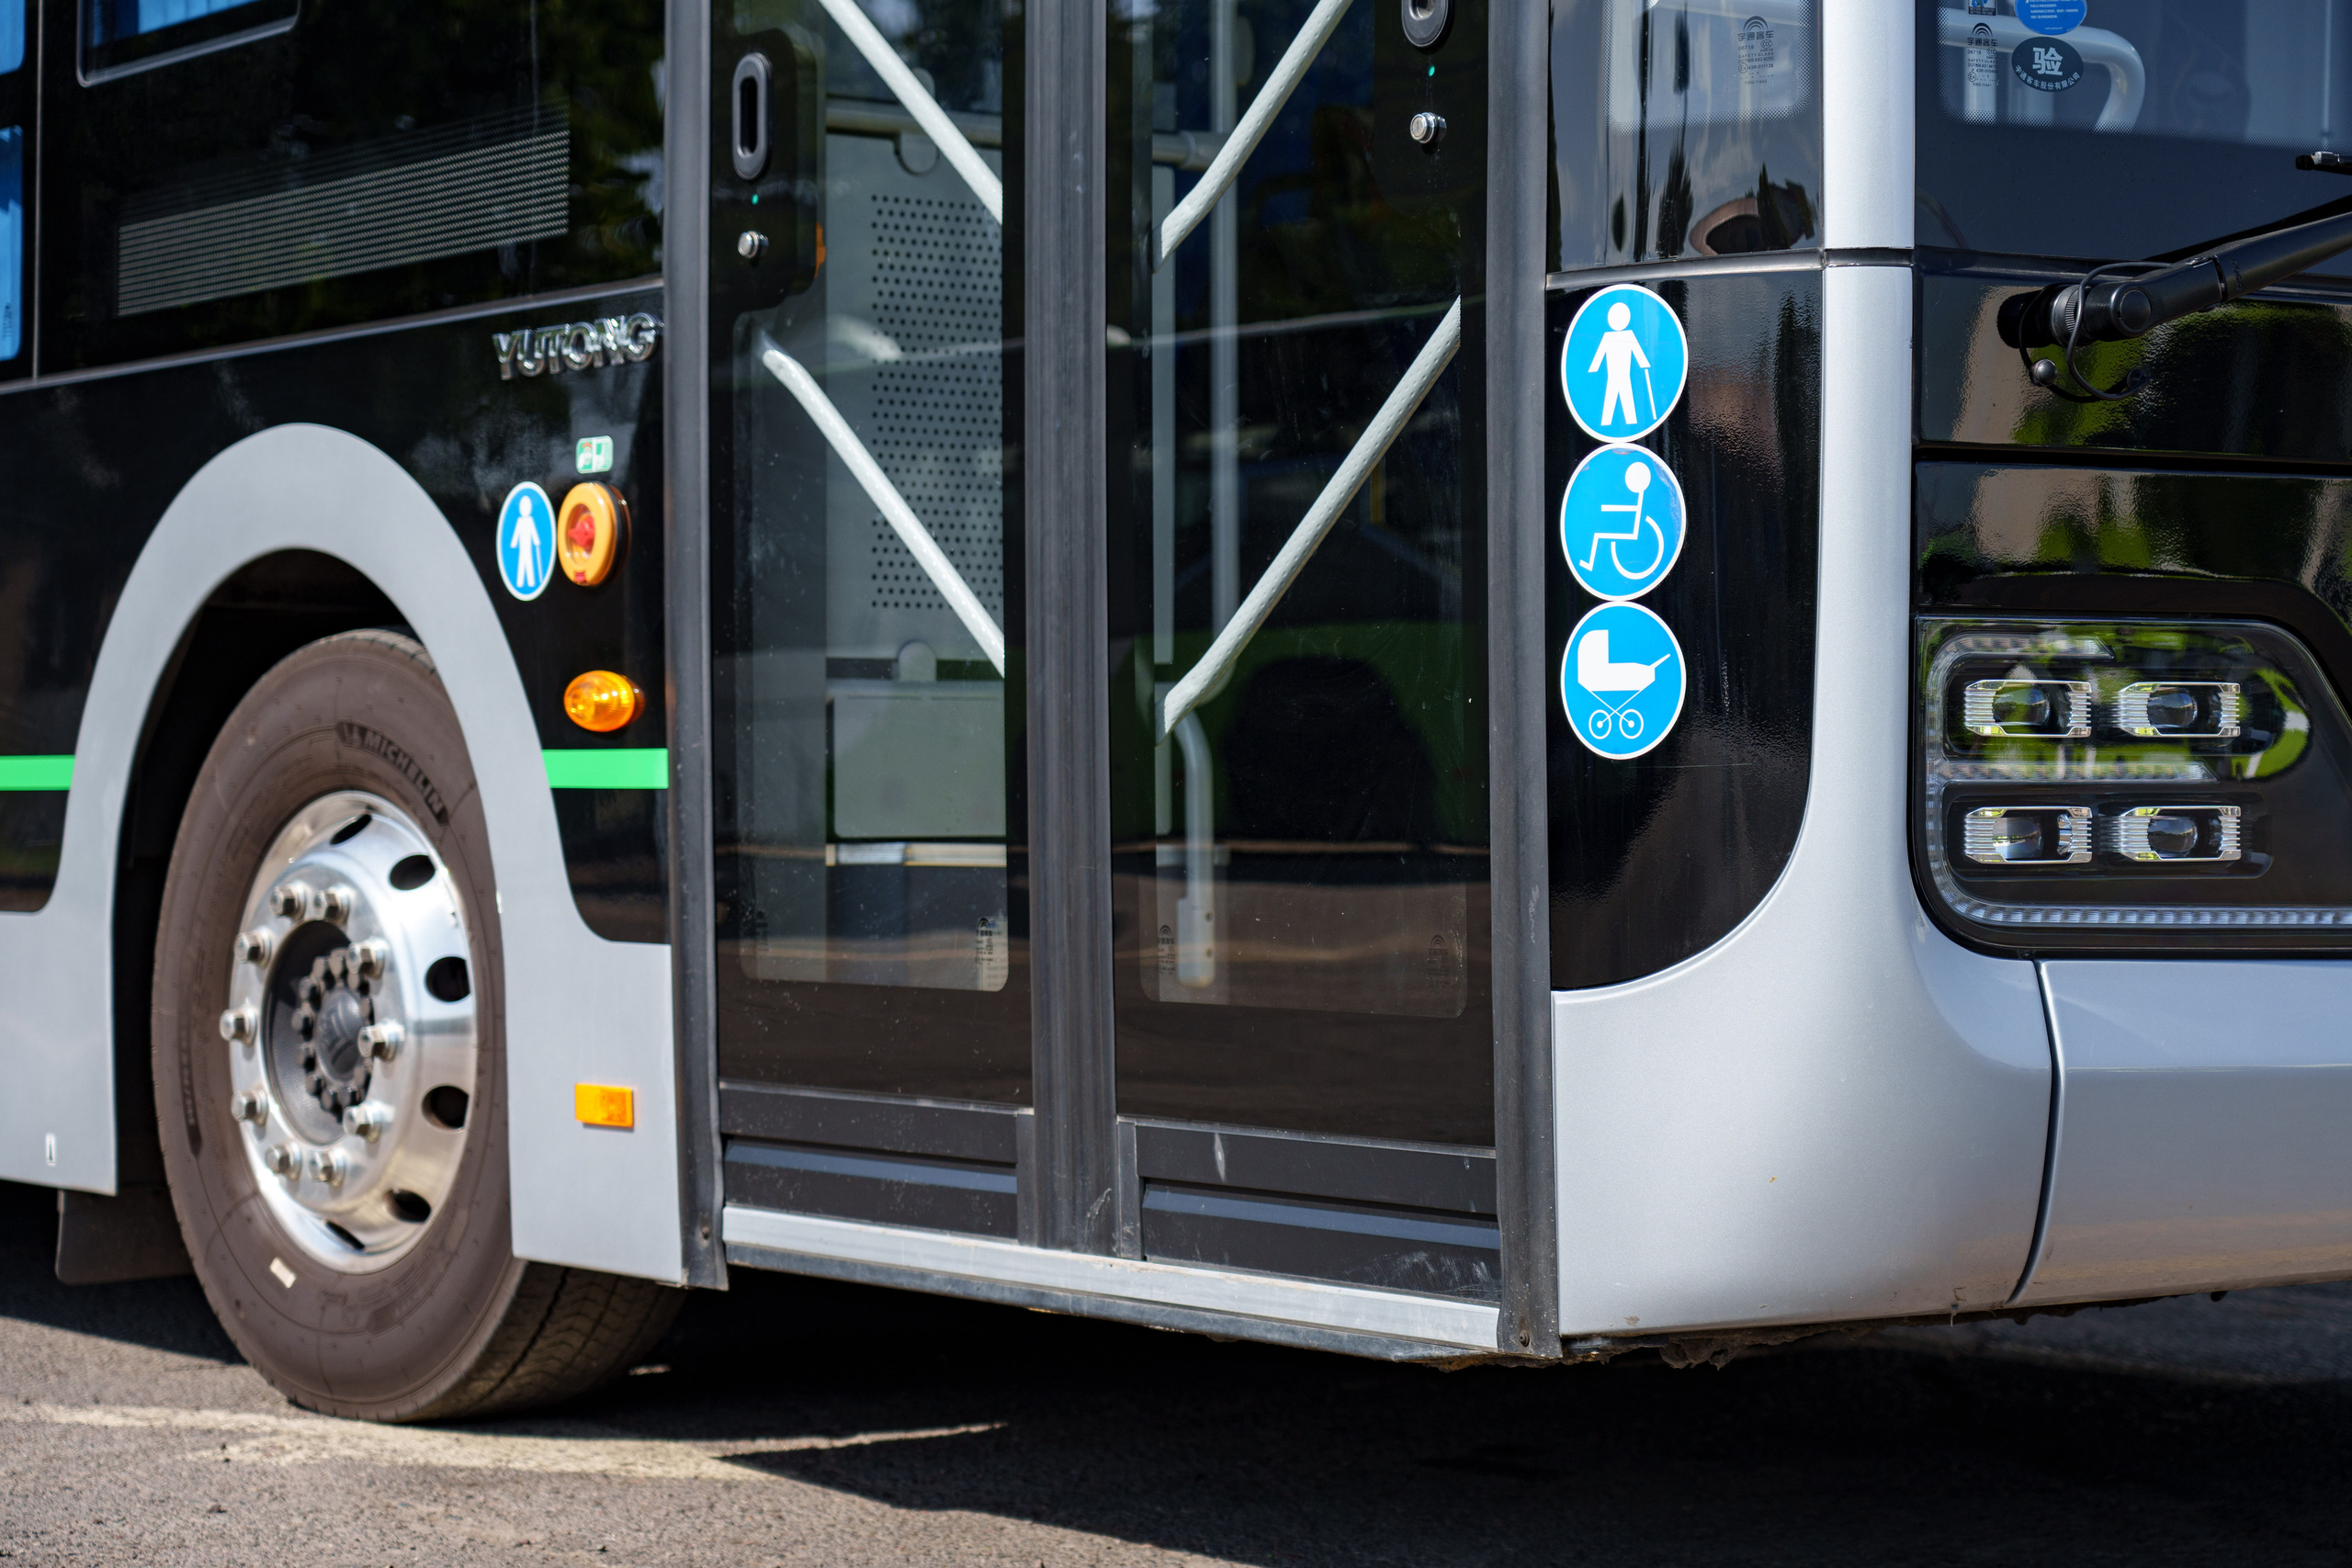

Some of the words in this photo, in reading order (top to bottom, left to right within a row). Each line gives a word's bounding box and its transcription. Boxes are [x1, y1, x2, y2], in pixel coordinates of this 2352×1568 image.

[1737, 30, 1774, 41] 宇通客车
[1967, 37, 1998, 47] 宇通客车
[2032, 47, 2064, 76] 验
[2015, 64, 2081, 90] 宇通客车股份有限公司
[492, 311, 659, 381] YUTONG
[364, 729, 446, 815] MICHELIN
